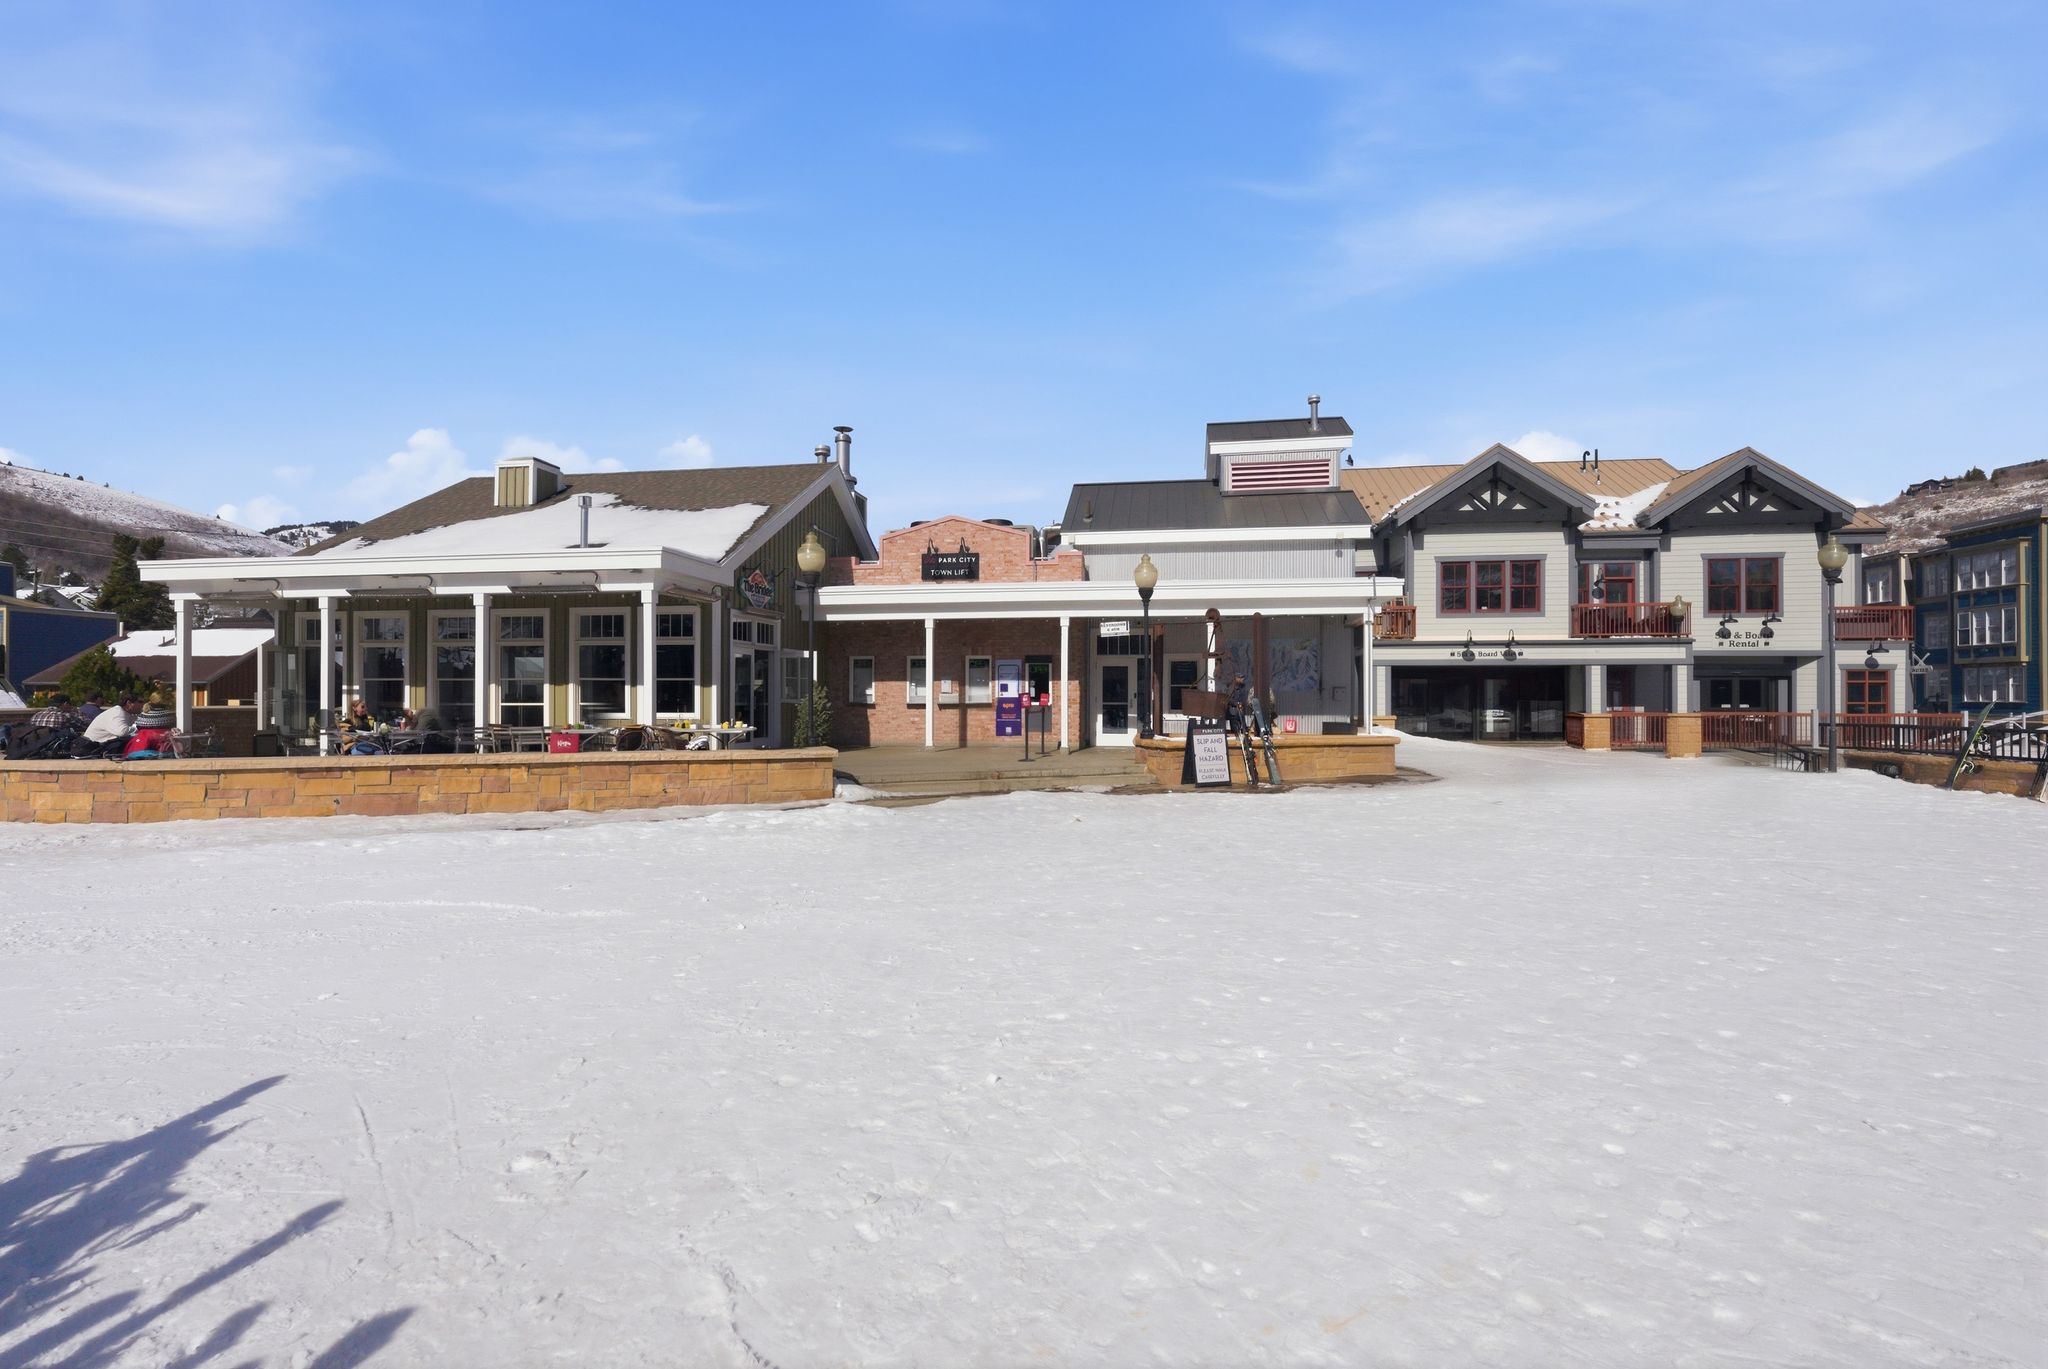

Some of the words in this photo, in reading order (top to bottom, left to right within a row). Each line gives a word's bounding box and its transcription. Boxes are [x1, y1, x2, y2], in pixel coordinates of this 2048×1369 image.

[1733, 631, 1743, 639] &
[1728, 640, 1760, 648] Rental
[1198, 754, 1225, 762] HAZARD
